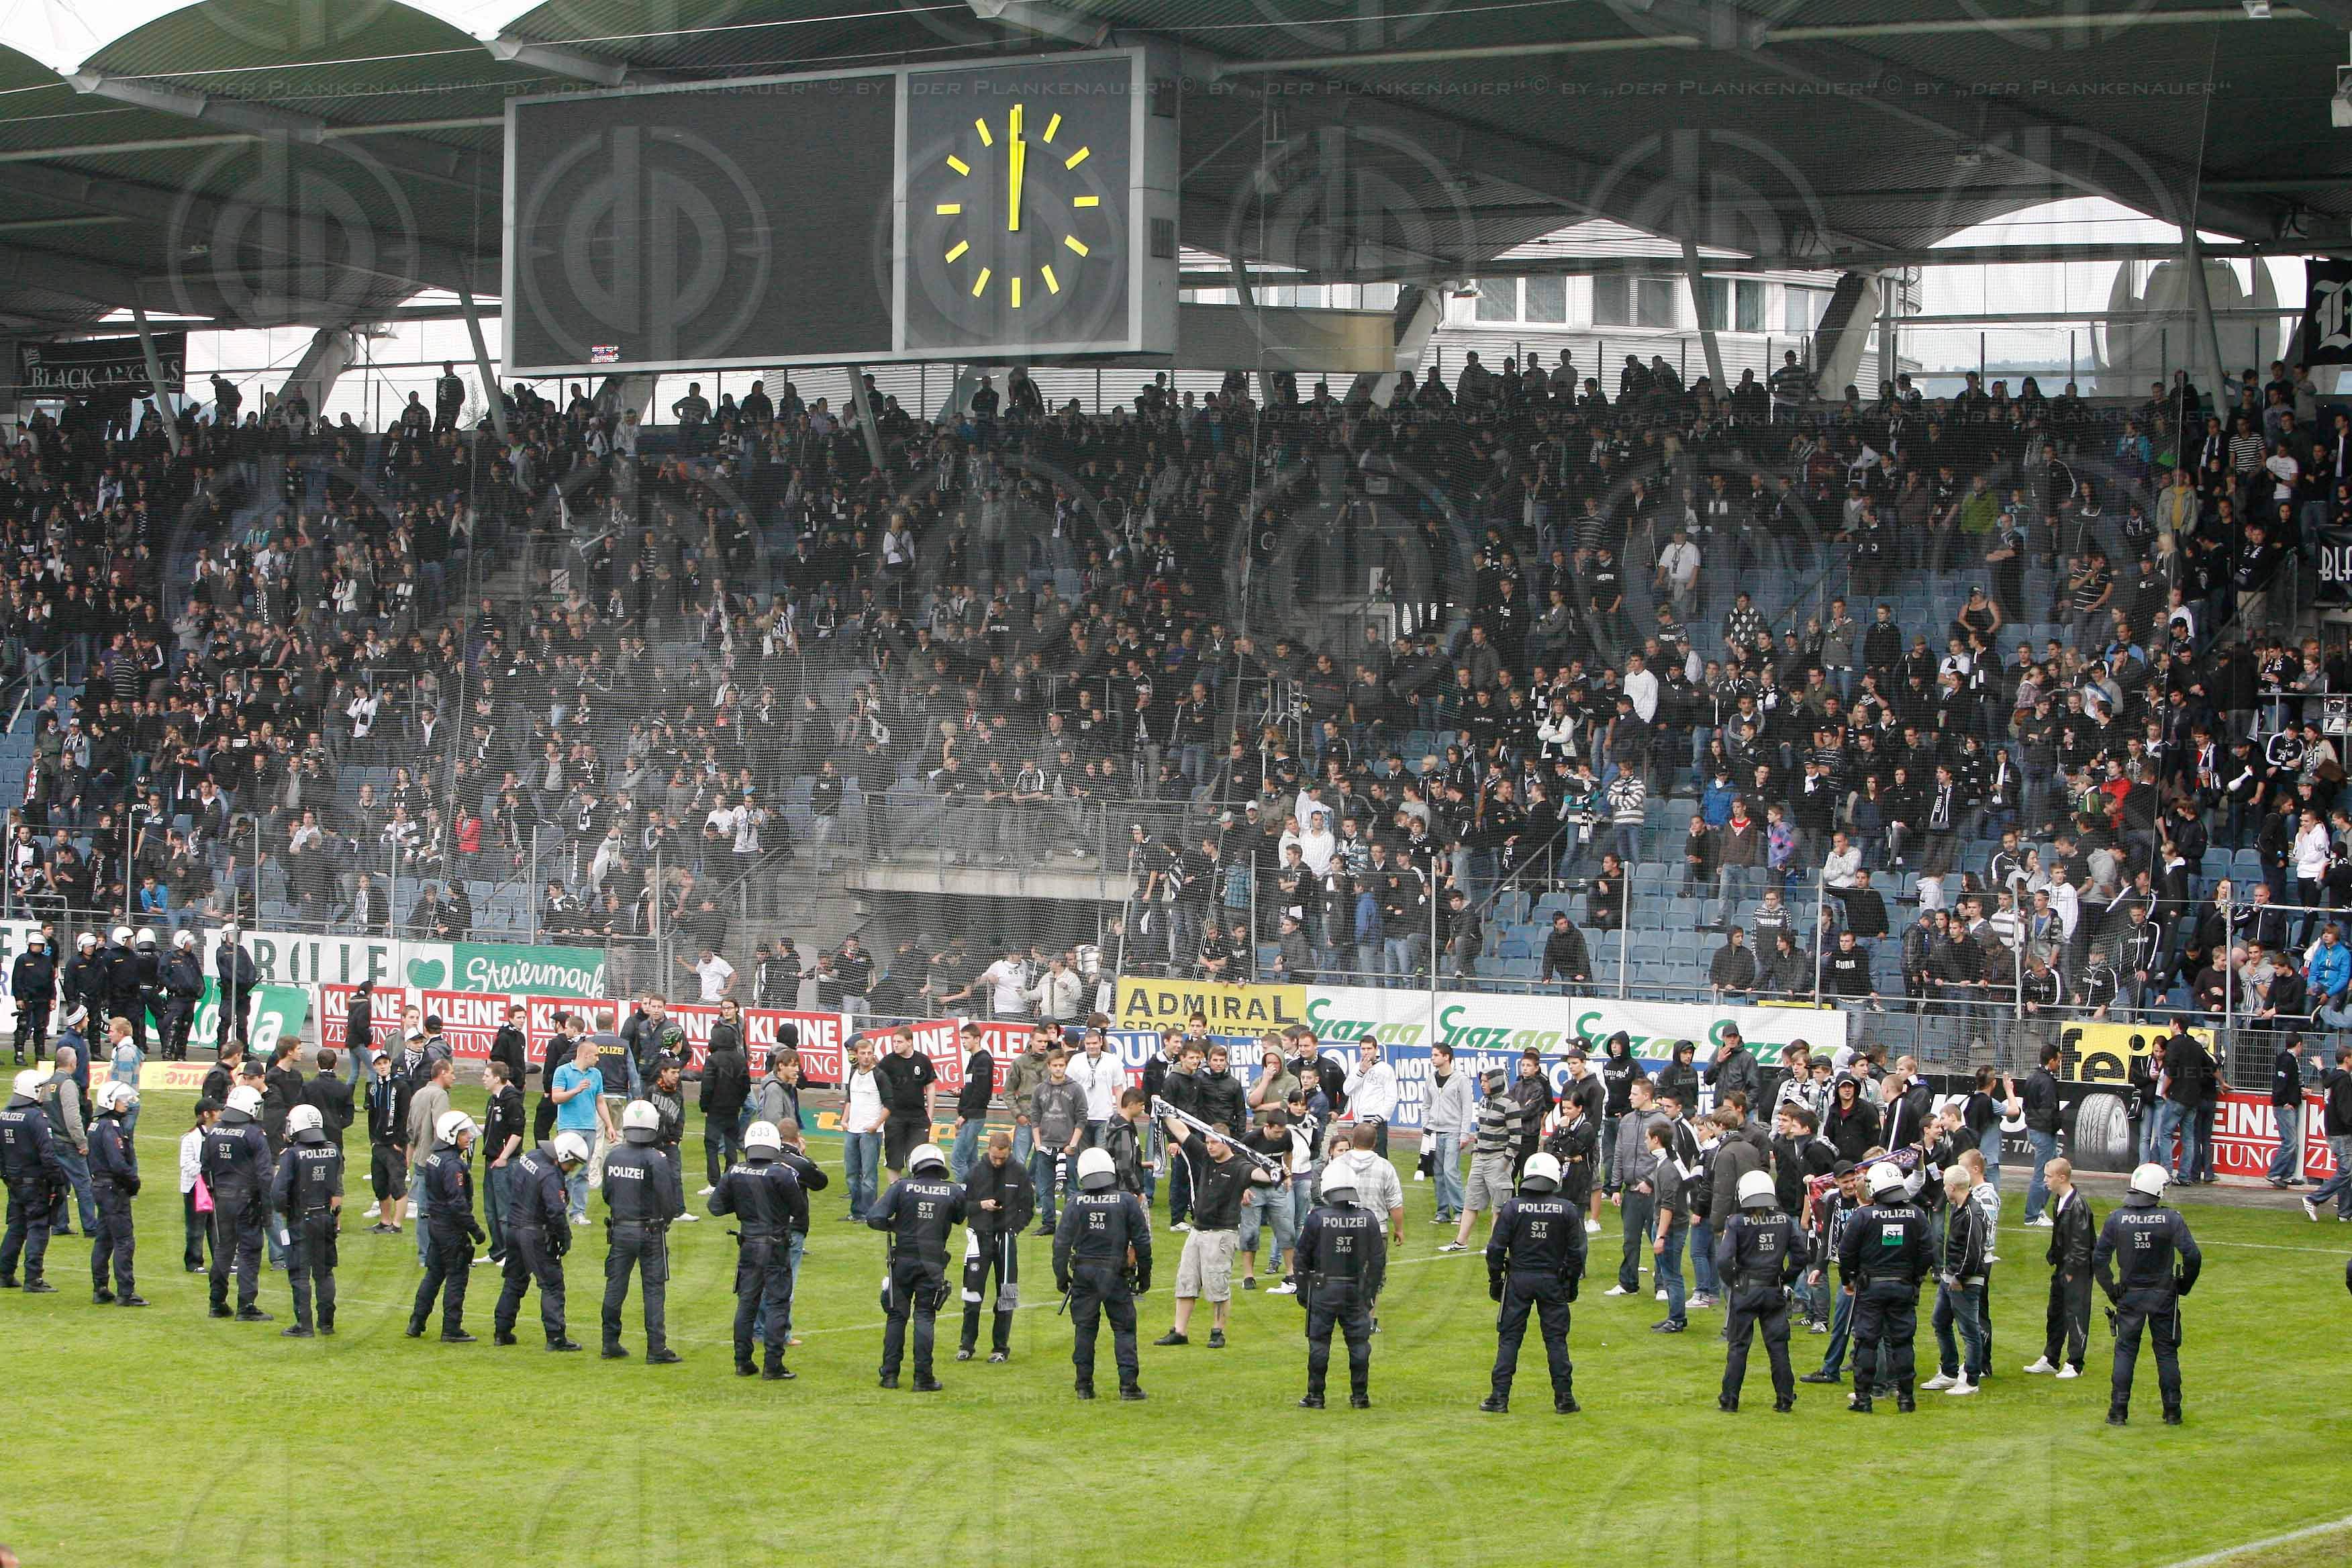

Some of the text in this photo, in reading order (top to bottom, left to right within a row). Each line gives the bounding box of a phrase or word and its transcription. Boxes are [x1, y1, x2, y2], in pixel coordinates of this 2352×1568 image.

[32, 366, 96, 389] BLACK
[1125, 988, 1300, 1024] ADMIRAL
[426, 997, 506, 1028] KLEINE
[597, 1046, 625, 1055] OLIZEI
[210, 1126, 246, 1138] POLIZEI
[219, 1143, 231, 1152] ST
[299, 1148, 337, 1160] POLIZEI
[313, 1165, 326, 1174] ST
[608, 1165, 644, 1180] POLIZEI
[906, 1183, 950, 1196] POLIZEI
[1077, 1194, 1120, 1205] POLIZEI
[918, 1202, 935, 1212] ST
[1518, 1203, 1563, 1214] POLIZEI
[918, 1211, 934, 1220] 320
[1089, 1212, 1106, 1222] ST
[1871, 1209, 1916, 1219] POLIZEI
[2120, 1214, 2166, 1224] POLIZEI
[1322, 1216, 1367, 1228] POLIZEI
[1743, 1214, 1787, 1226] POLIZEI
[1089, 1222, 1105, 1230] 340
[1531, 1221, 1549, 1231] ST
[1759, 1233, 1775, 1243] ST
[1885, 1230, 1900, 1240] ST
[2134, 1232, 2151, 1241] ST
[1336, 1236, 1353, 1246] ST
